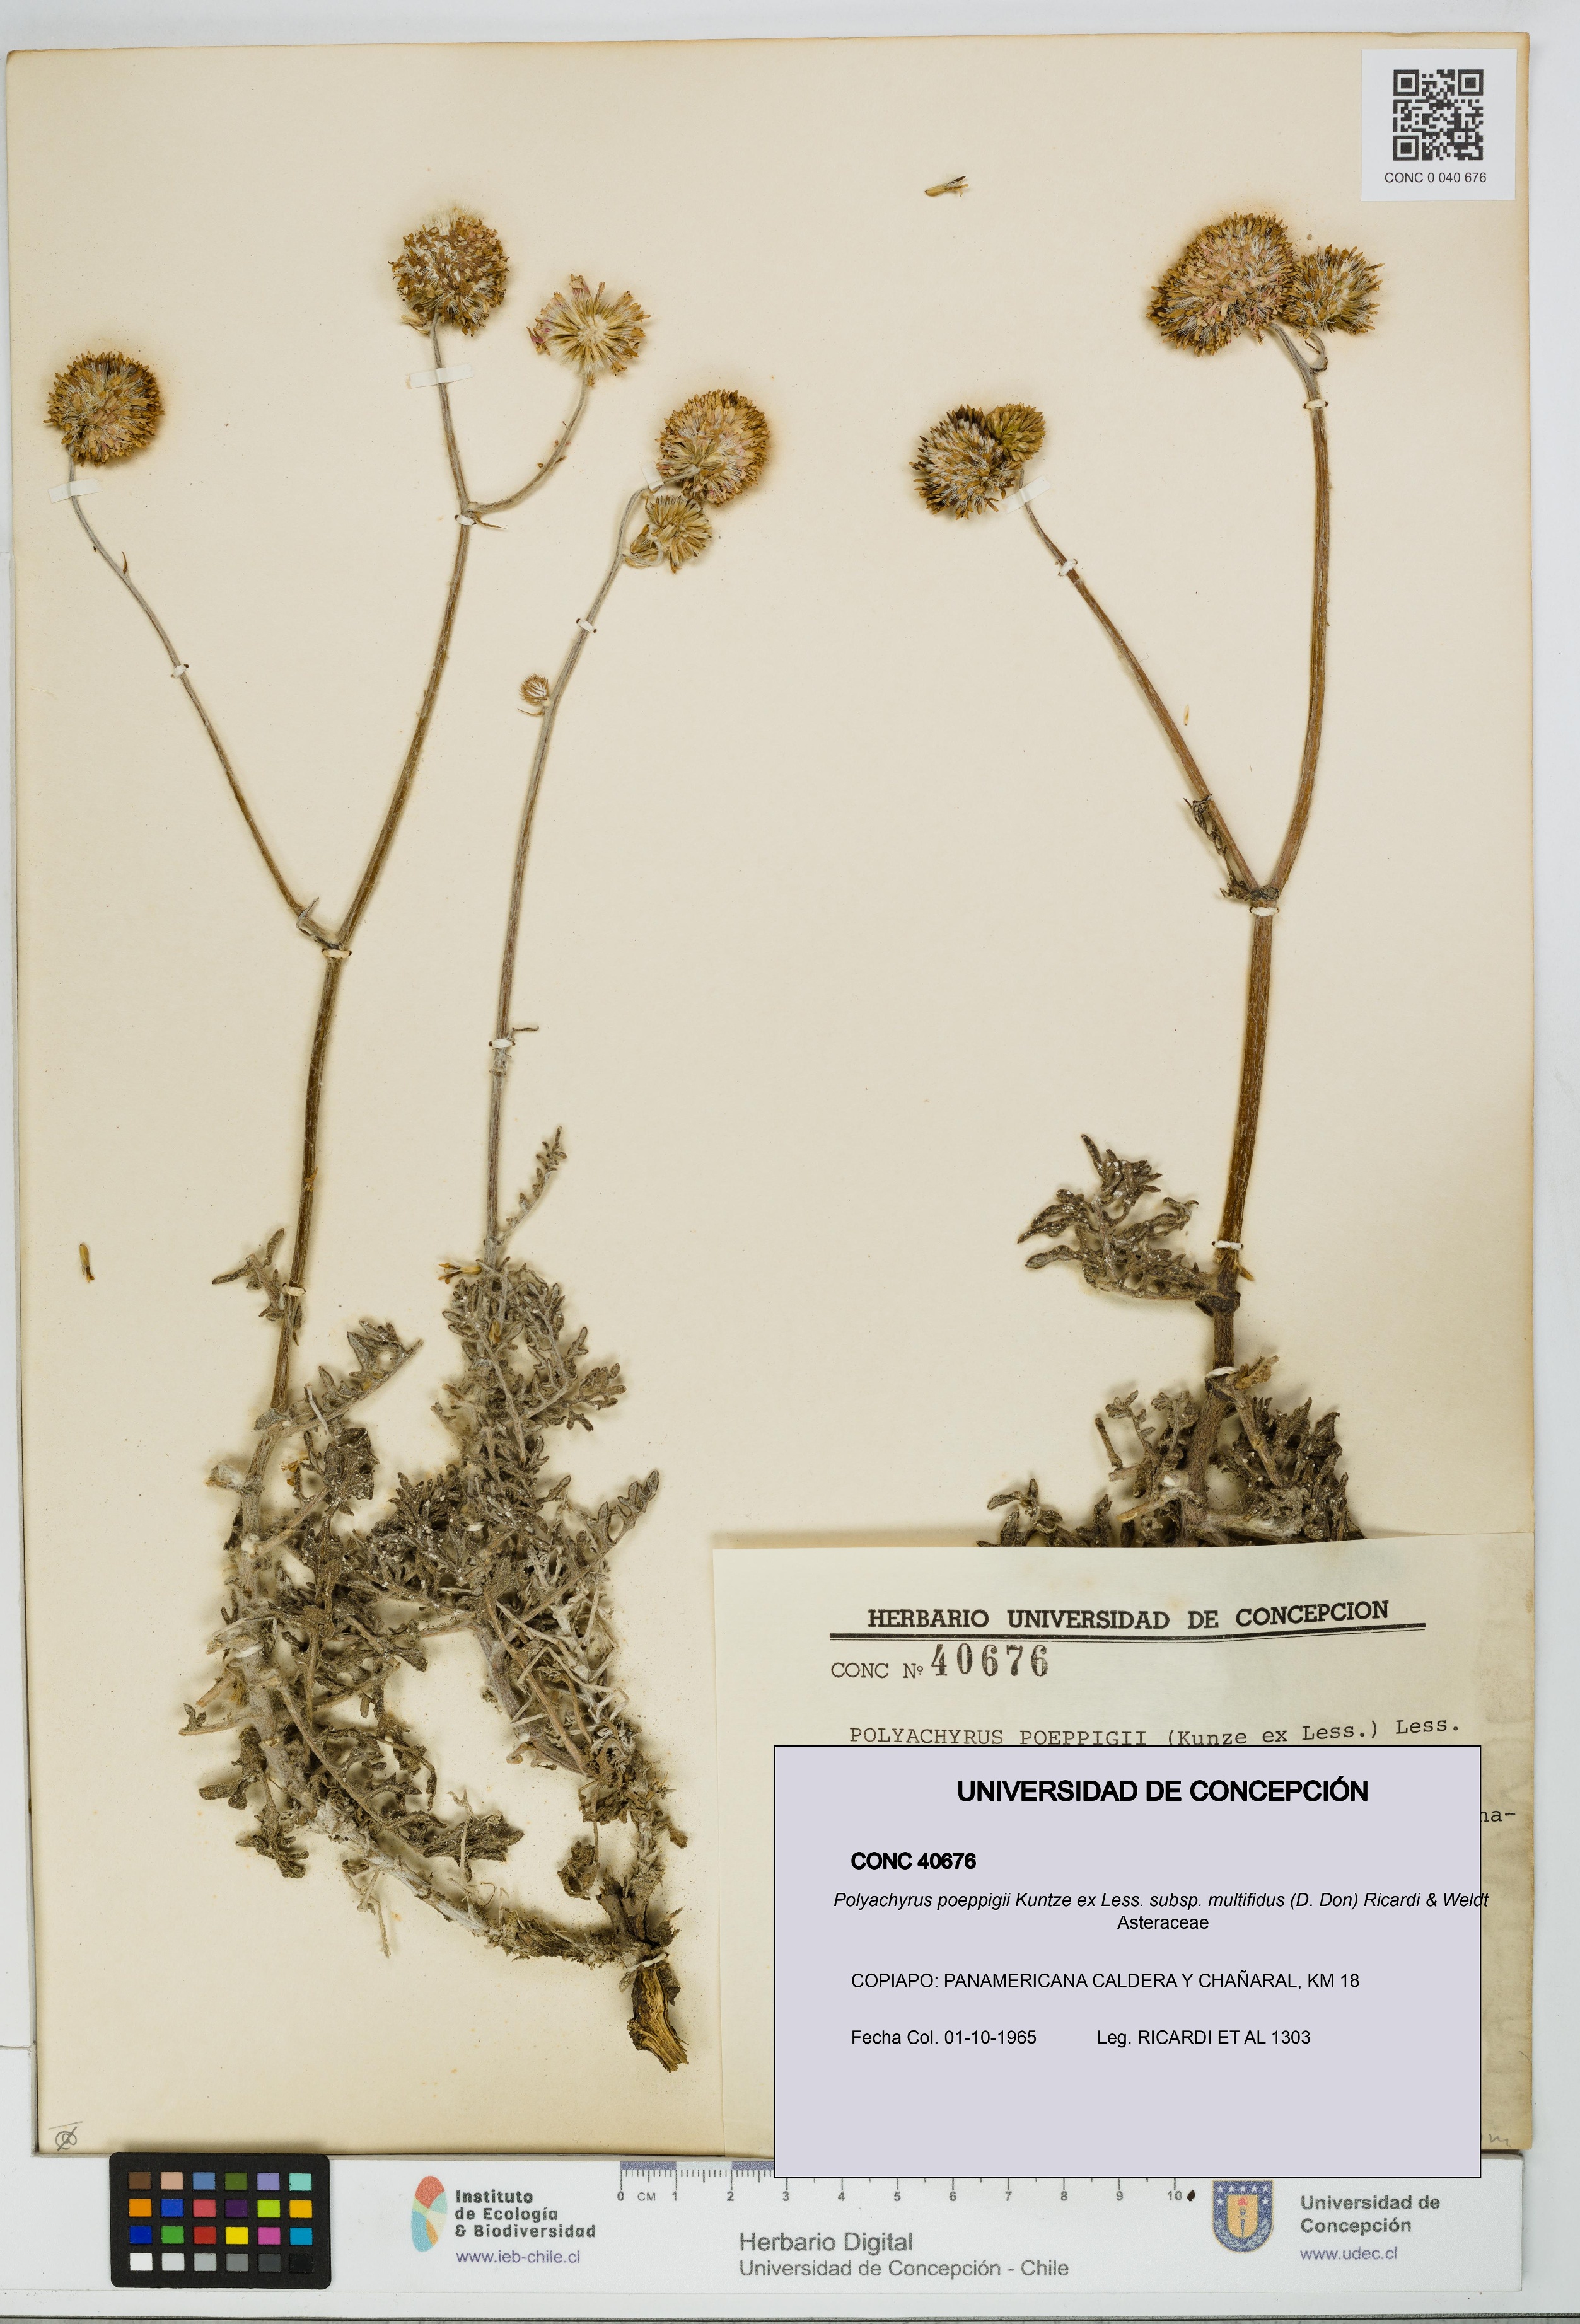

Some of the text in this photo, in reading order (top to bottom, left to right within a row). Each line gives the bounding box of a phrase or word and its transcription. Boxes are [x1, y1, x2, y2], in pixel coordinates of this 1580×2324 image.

[1385, 172, 1487, 183] CONC 0 040 676
[868, 1600, 1389, 1630] HERBARIO UNIVERSIDAD DE CONCEPCION
[831, 1662, 889, 1679] CONC
[931, 1643, 1048, 1677] 40676
[849, 1720, 1458, 1745] POLYACHYRUS POEPPIGII (Kunze ex Less.) Less.
[456, 2188, 533, 2204] Instituto
[617, 2190, 1182, 2202] 0 CM 1 2 3 4 5 6 7 8 9 10
[1301, 2194, 1441, 2210] Universidad de
[455, 2206, 557, 2223] de Ecología
[455, 2223, 595, 2238] & Biodiversidad
[1301, 2217, 1412, 2236] Concepción
[740, 2232, 913, 2257] Herbario Digital
[456, 2249, 580, 2264] www.ieb-chile.cl
[1299, 2246, 1398, 2260] www.udec.cl
[740, 2260, 851, 2276] Universidad
[858, 2260, 881, 2276] de
[888, 2259, 1001, 2281] Concepción
[1021, 2259, 1069, 2276] Chile
